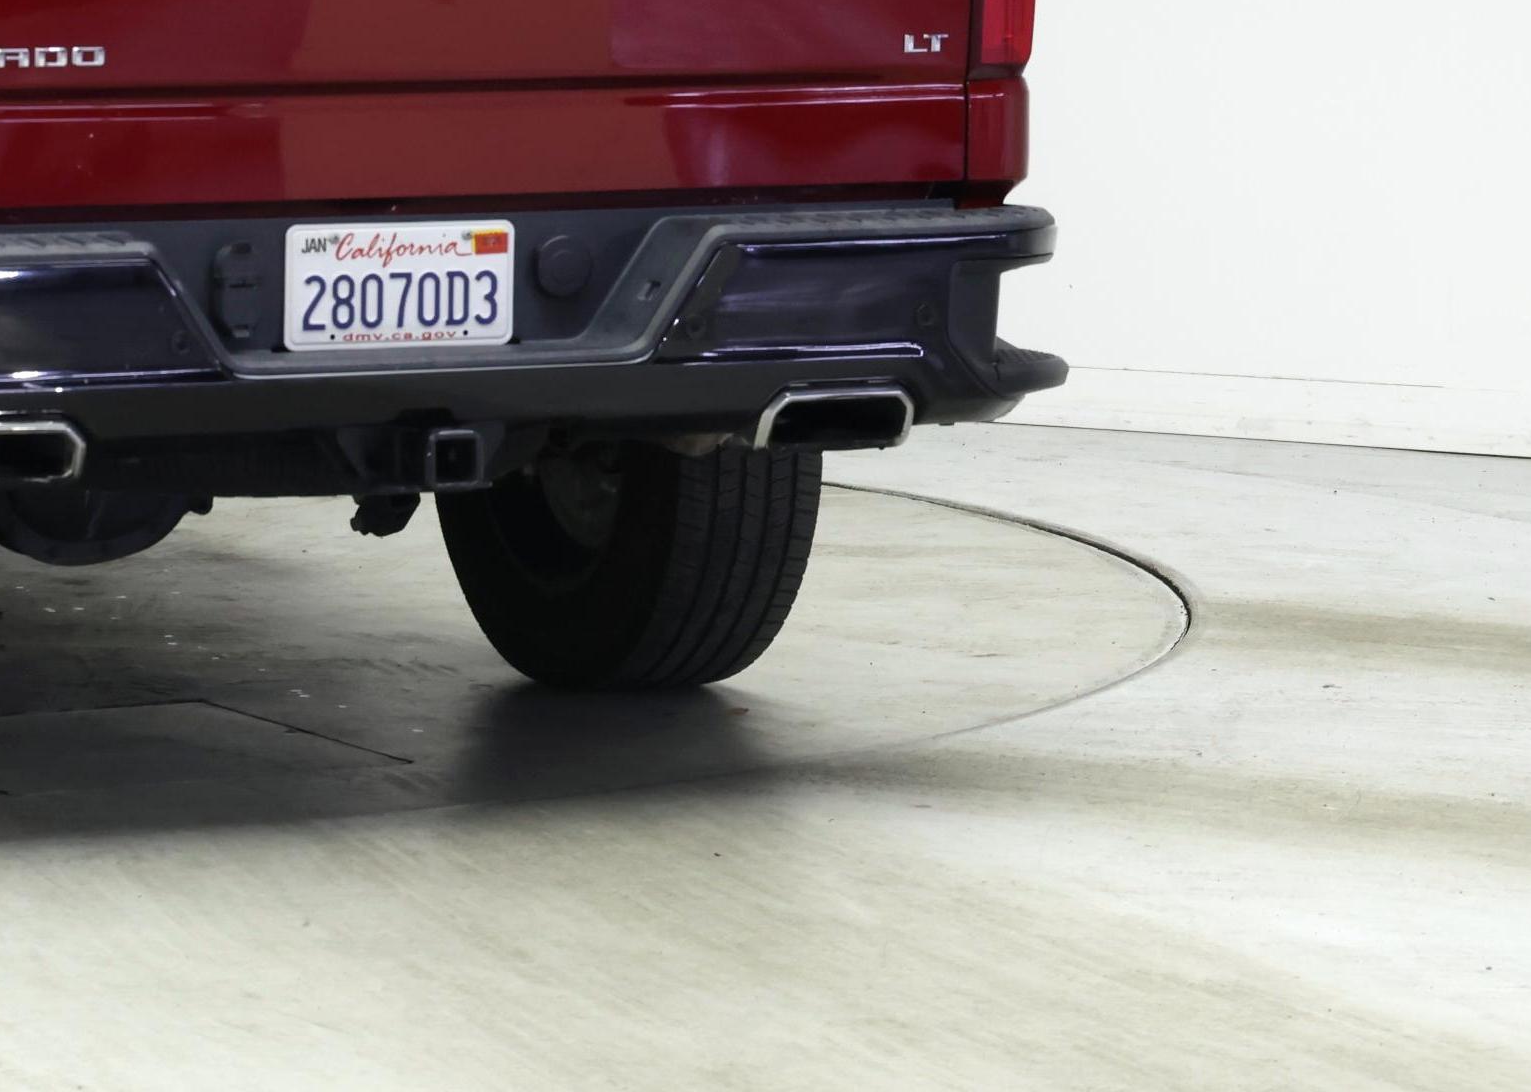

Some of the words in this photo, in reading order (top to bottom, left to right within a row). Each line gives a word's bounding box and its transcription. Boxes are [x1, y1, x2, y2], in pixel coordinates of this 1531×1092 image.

[904, 34, 949, 53] LT
[301, 237, 327, 253] JAN
[334, 232, 473, 268] California
[302, 269, 498, 331] 28070D3
[342, 330, 458, 341] dmv.ca.gov
